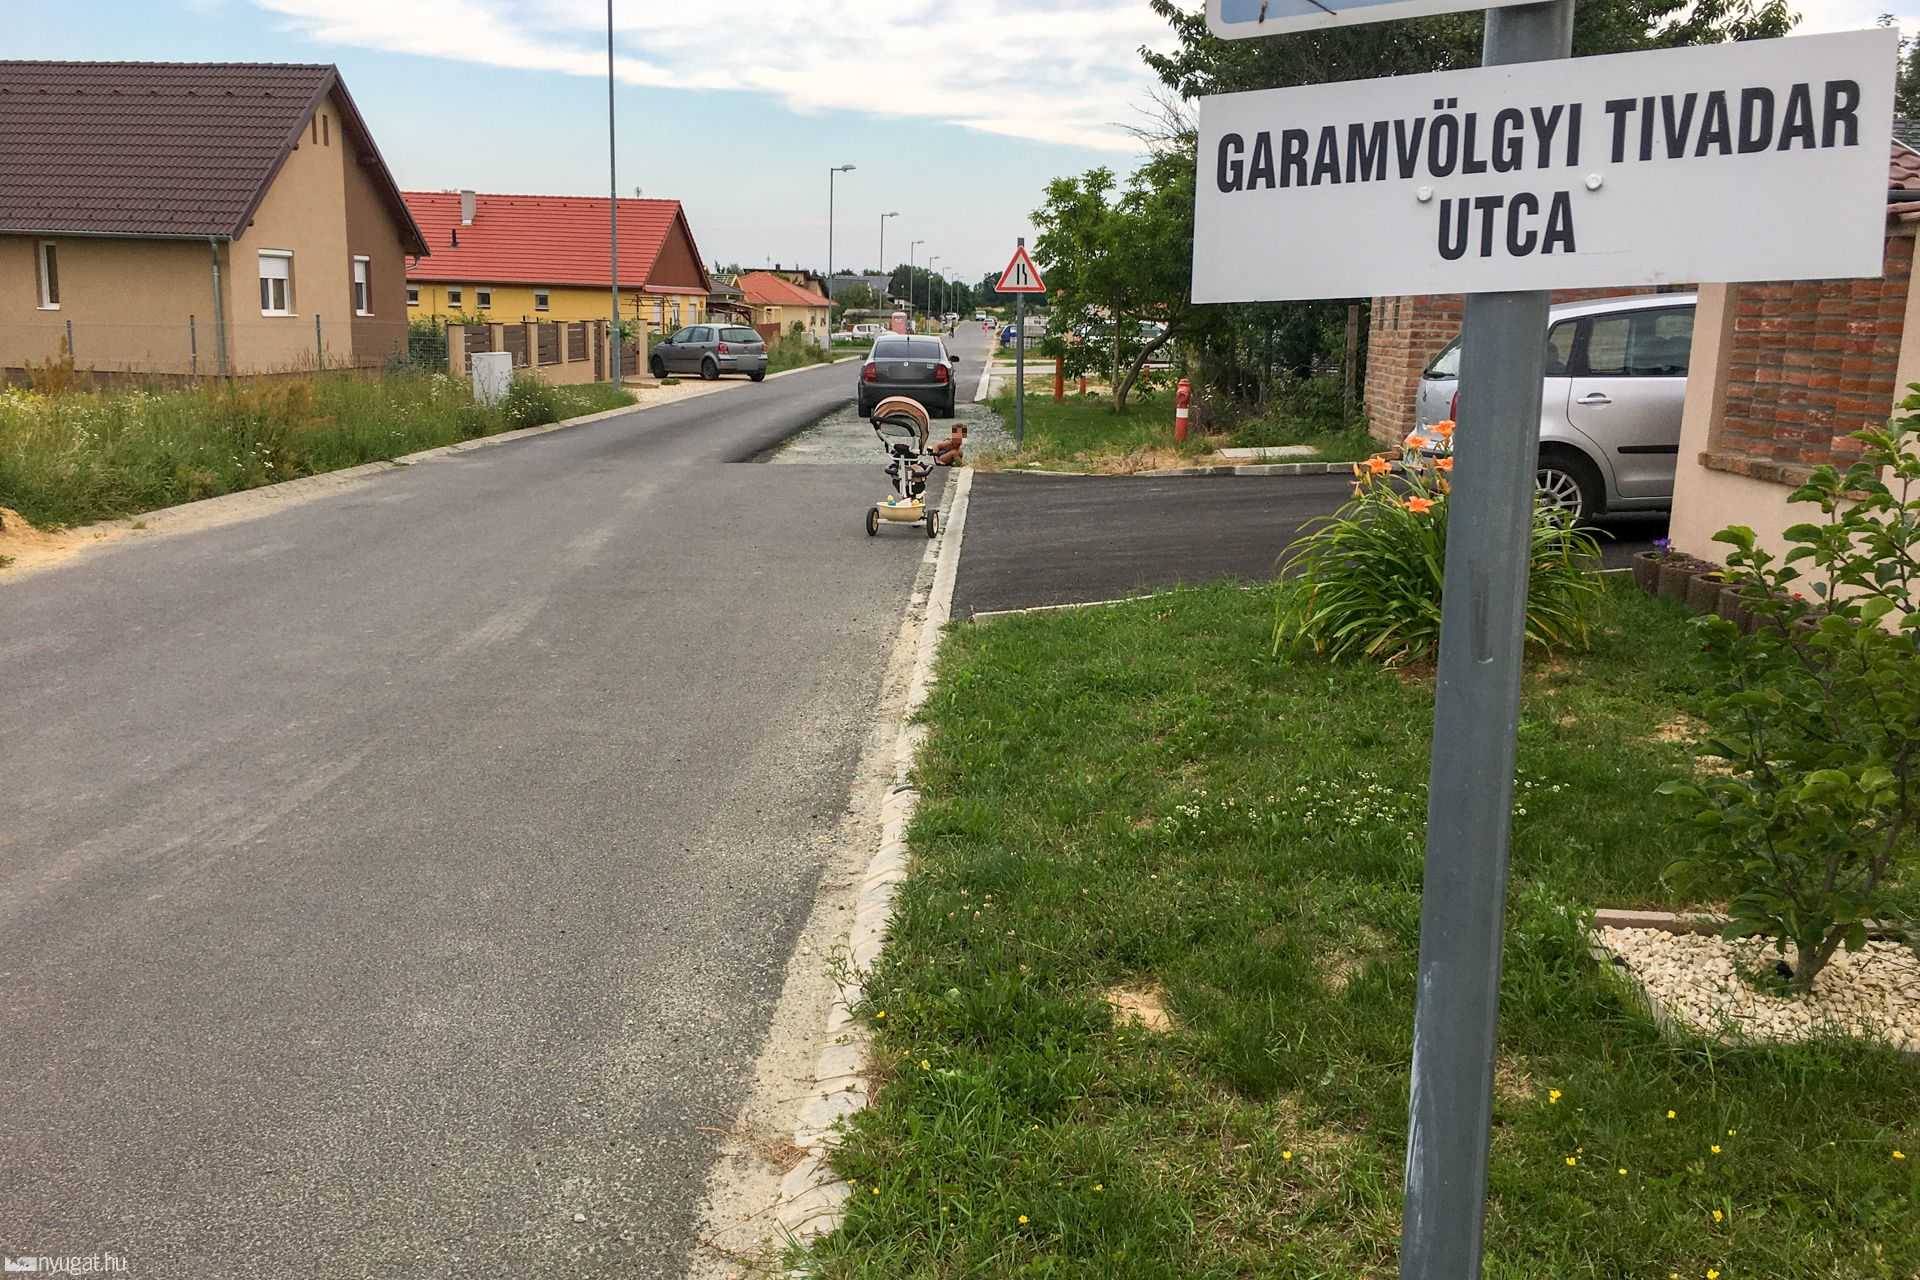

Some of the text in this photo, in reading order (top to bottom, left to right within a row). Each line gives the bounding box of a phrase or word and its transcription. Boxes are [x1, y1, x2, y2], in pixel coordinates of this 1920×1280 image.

[1216, 80, 1861, 194] GARAMVÖLGYI TIVADAR
[1438, 191, 1577, 261] UTCA
